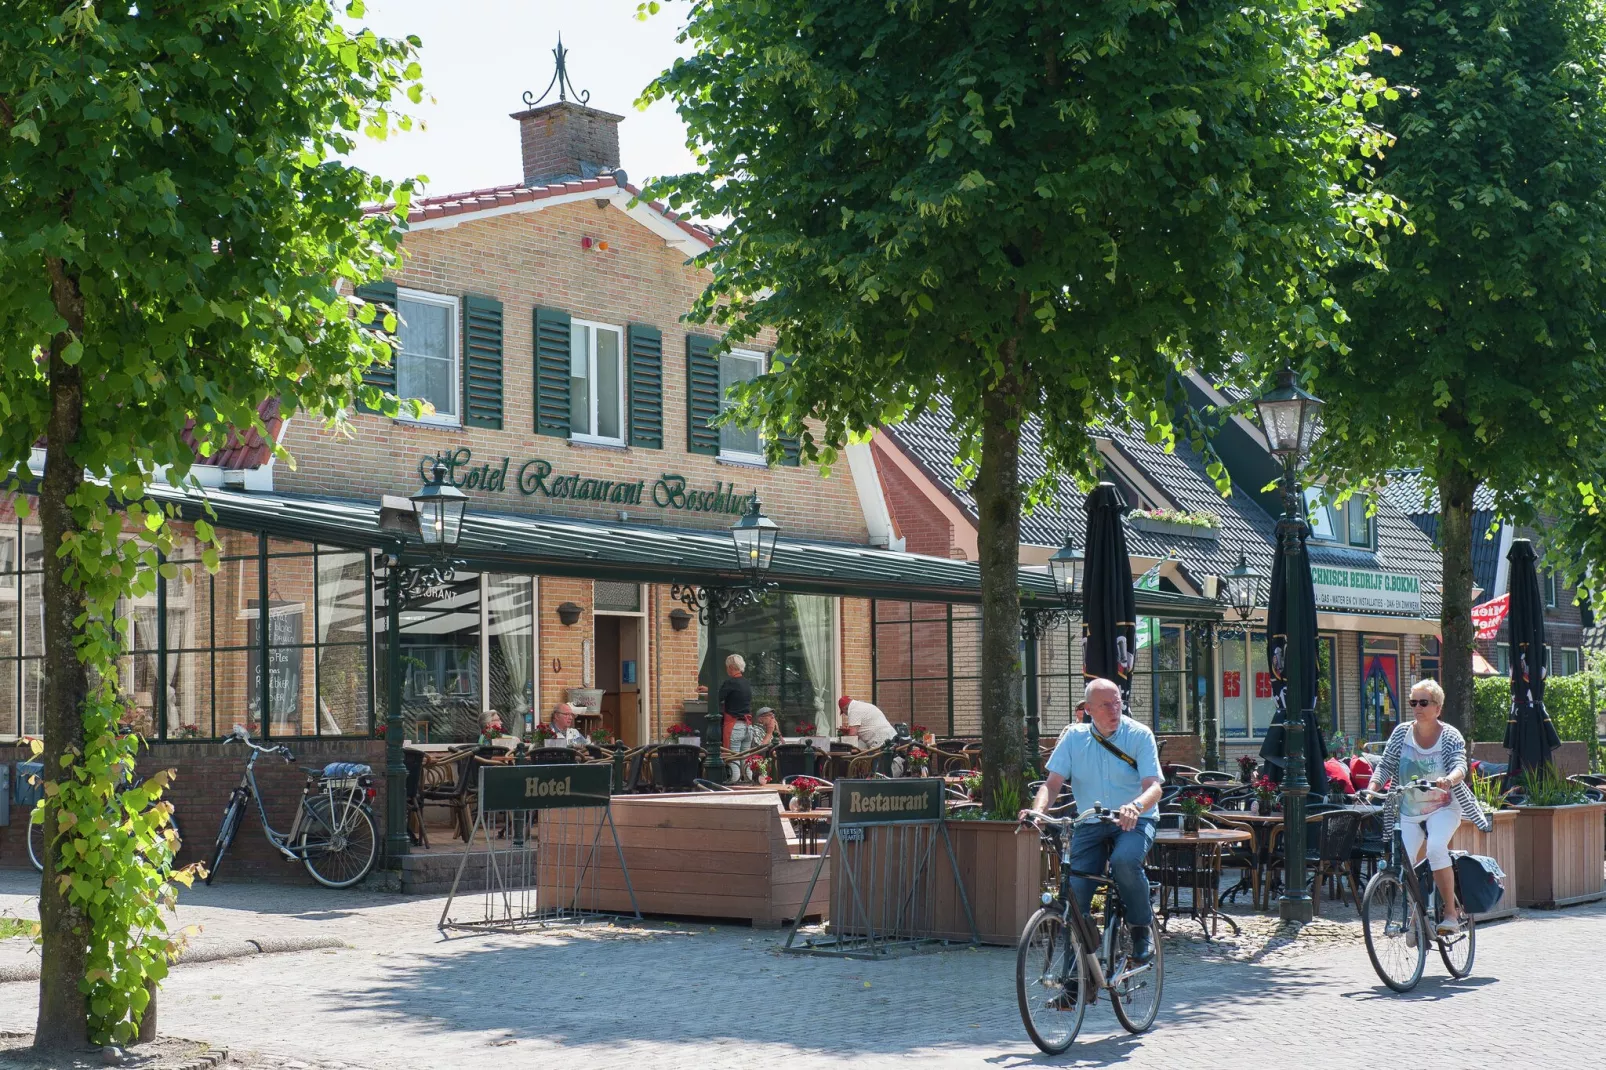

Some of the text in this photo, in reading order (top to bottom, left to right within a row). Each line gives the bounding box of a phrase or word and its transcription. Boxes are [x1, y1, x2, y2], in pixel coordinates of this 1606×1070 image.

[420, 448, 756, 516] Hotel Restaurant Boschlus
[1311, 567, 1420, 594] CHNISCH BEDRIJF G.BOKMA
[1321, 593, 1330, 604] GAS
[1332, 595, 1345, 606] WATER
[1359, 597, 1383, 608] INSTALLATIES
[524, 776, 571, 797] Hotel
[849, 791, 929, 813] Restaurant
